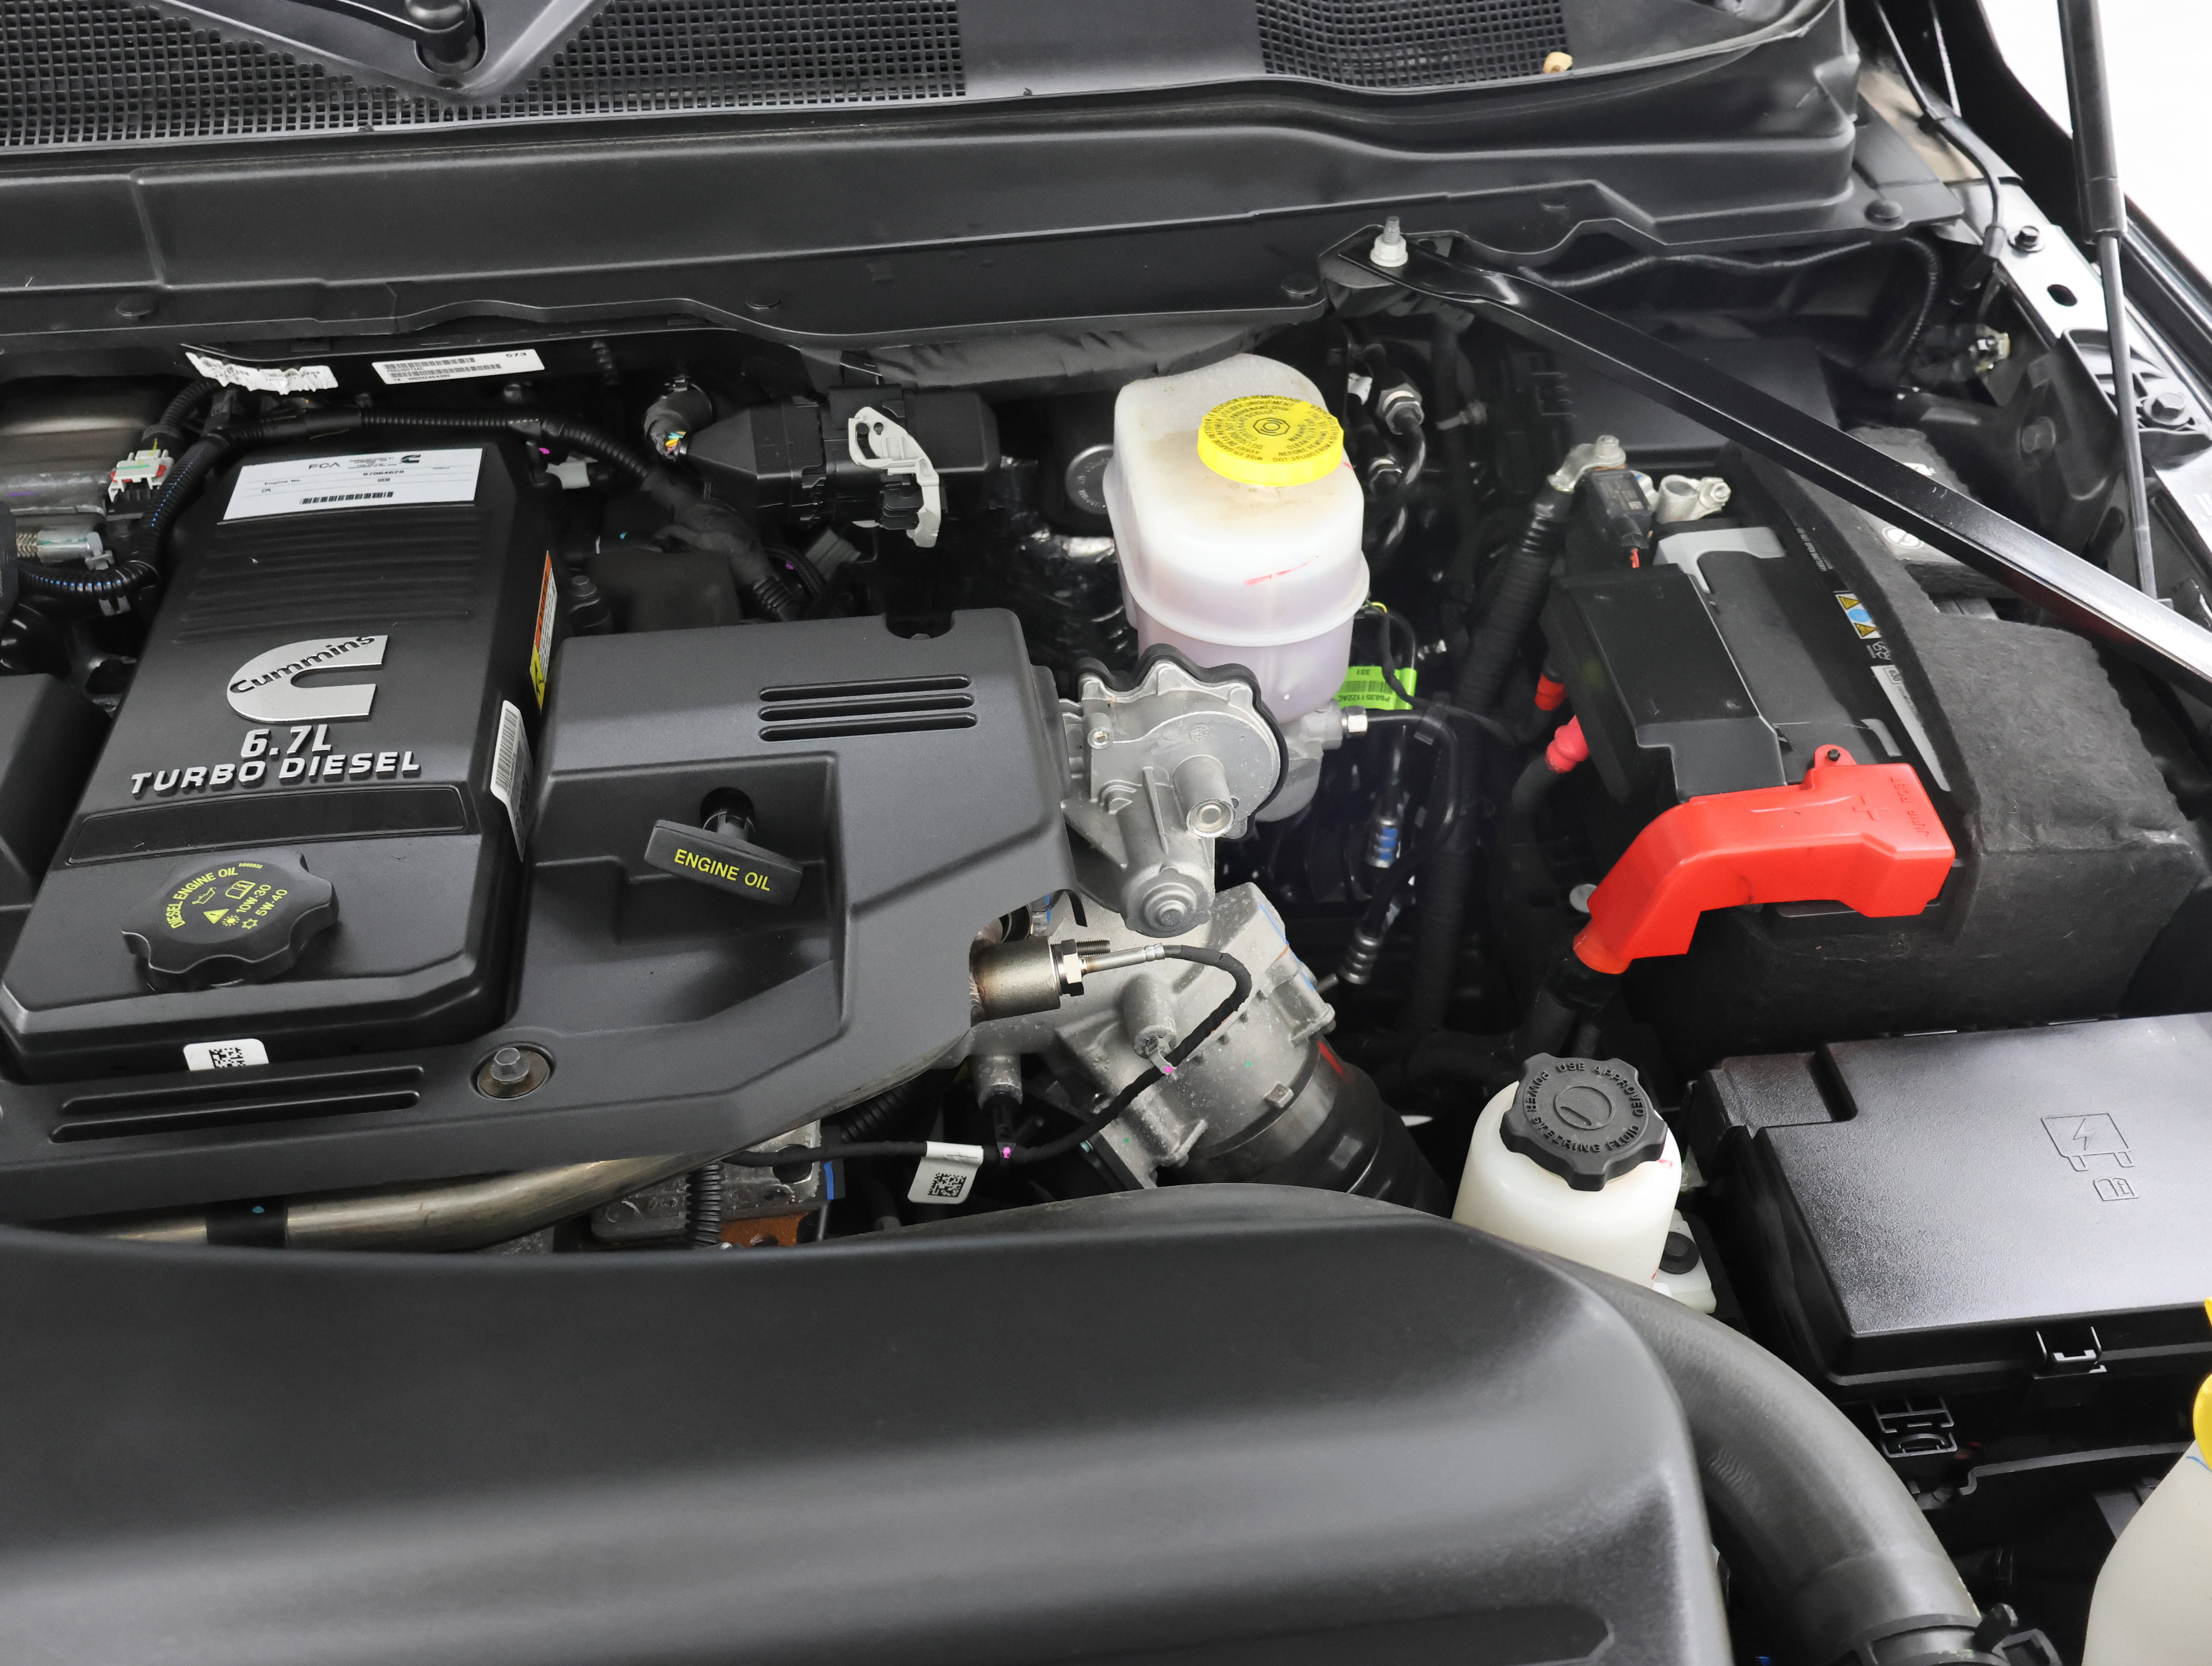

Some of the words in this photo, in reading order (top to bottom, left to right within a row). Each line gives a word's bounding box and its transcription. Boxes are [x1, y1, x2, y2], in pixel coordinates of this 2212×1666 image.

[1287, 424, 1306, 442] WARNING
[1278, 447, 1307, 457] BEFORE
[1296, 451, 1317, 461] FLUID
[229, 636, 375, 694] Cummins
[240, 724, 333, 760] 6.7L
[132, 760, 268, 797] TURBO
[278, 750, 420, 781] DIESEL
[1890, 777, 1912, 803] POST
[1907, 810, 1930, 837] JUMP
[218, 867, 238, 878] OIL
[674, 848, 740, 882] ENGINE
[744, 871, 771, 892] OIL
[173, 872, 217, 904] ENGINE
[236, 884, 272, 913] 10W-30
[255, 889, 289, 916] 5W-40
[165, 900, 186, 929] DIESEL
[1524, 1071, 1551, 1113] POWER
[1556, 1061, 1586, 1073] USE
[1591, 1064, 1645, 1117] APPROVED
[1532, 1116, 1602, 1153] STEERING
[1605, 1124, 1641, 1152] FLUID
